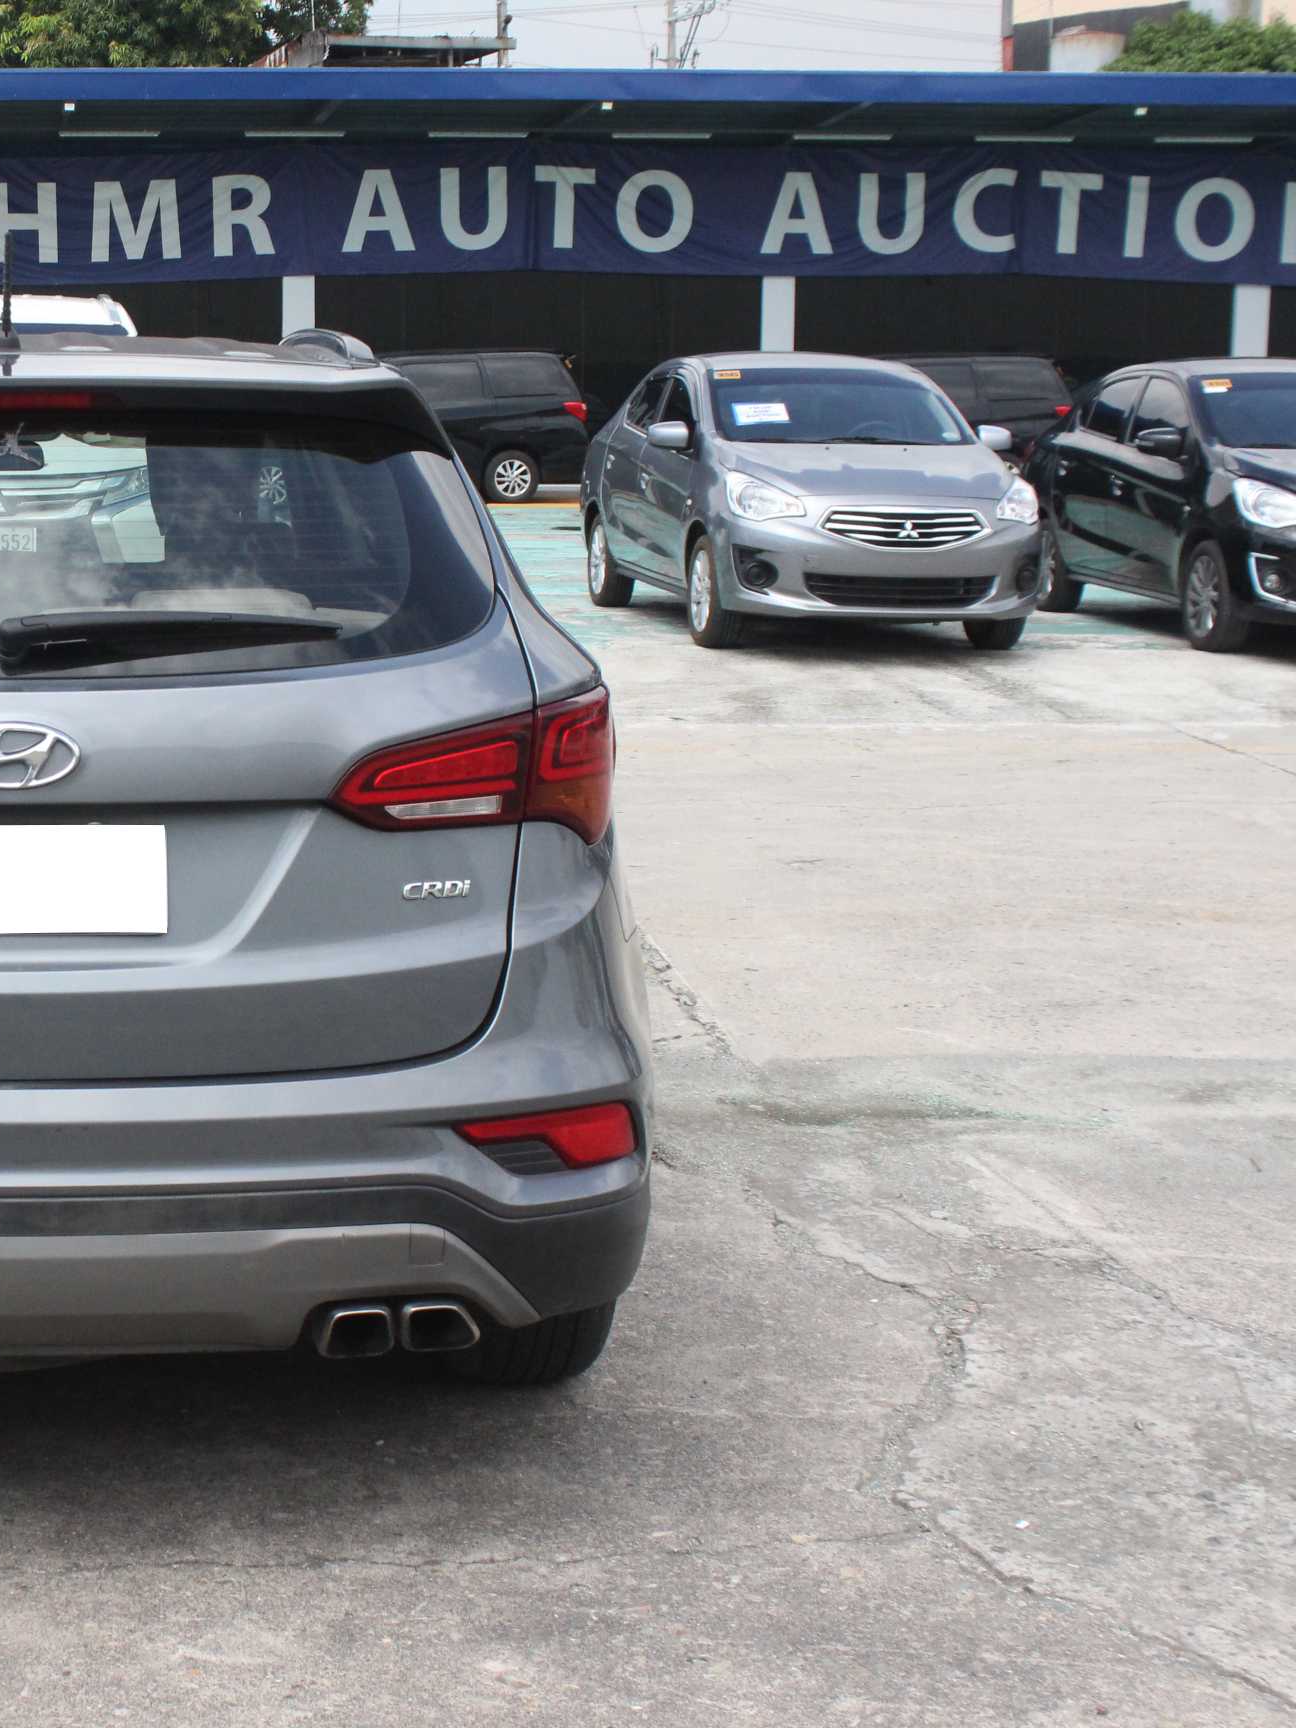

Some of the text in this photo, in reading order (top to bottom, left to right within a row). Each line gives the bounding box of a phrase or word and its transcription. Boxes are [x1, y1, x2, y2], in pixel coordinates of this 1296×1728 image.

[341, 164, 694, 253] AUTO
[759, 167, 1296, 264] AUCTIO
[402, 879, 472, 900] CRDi
